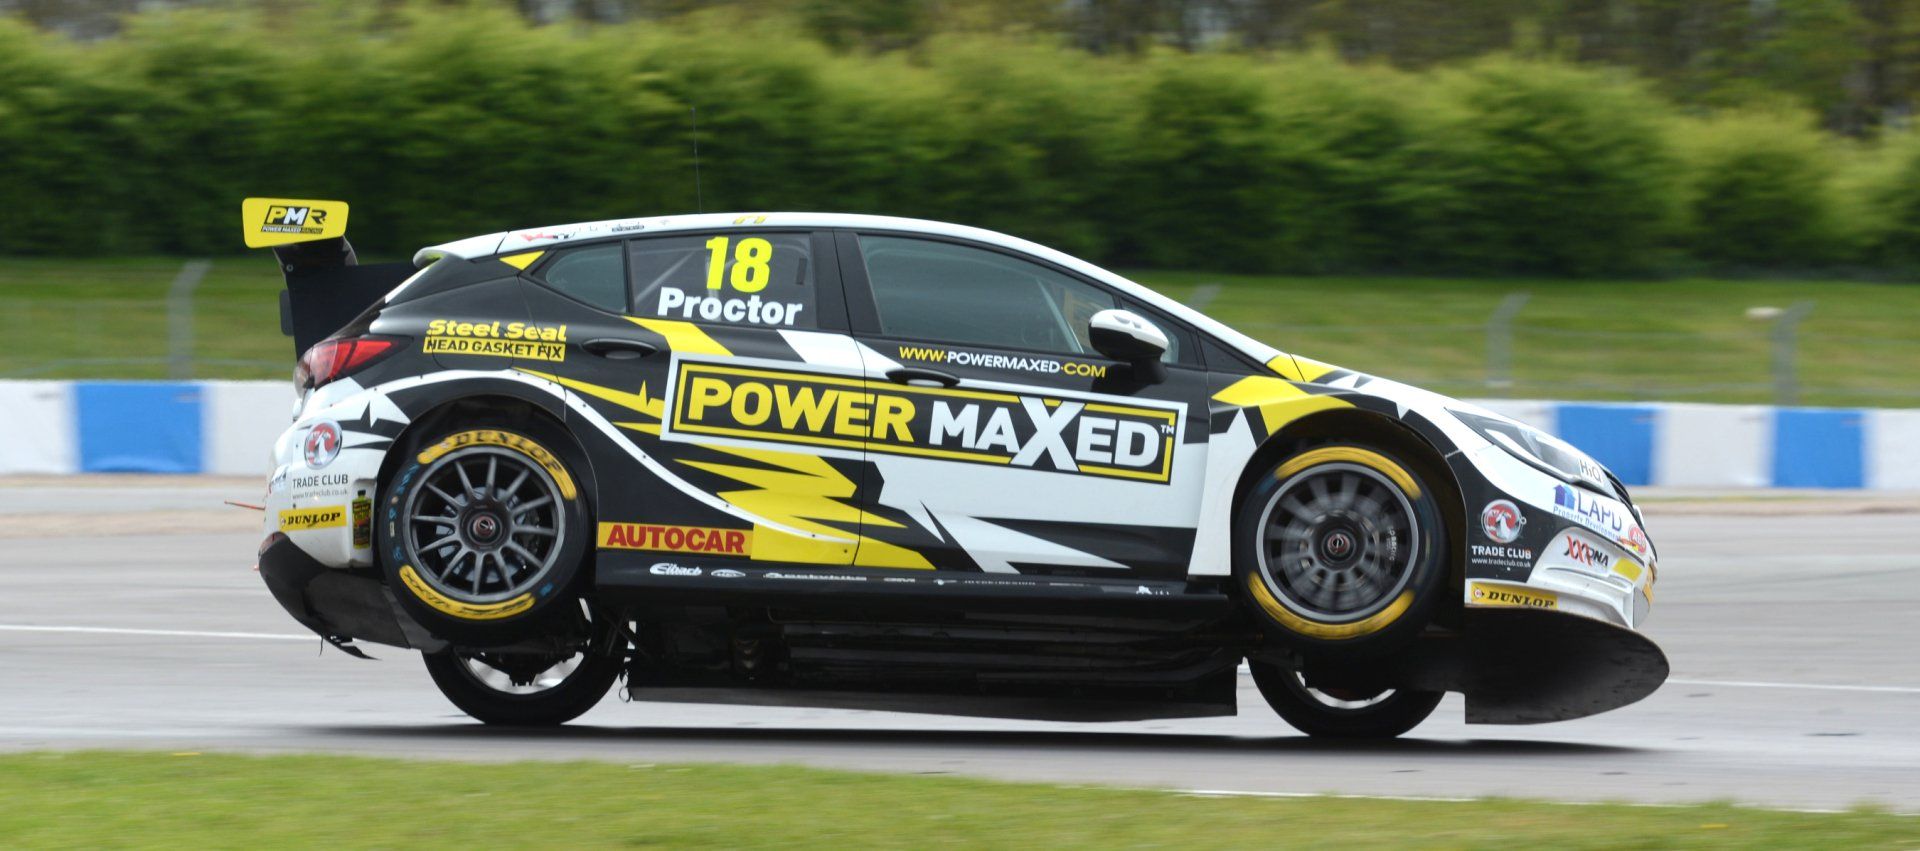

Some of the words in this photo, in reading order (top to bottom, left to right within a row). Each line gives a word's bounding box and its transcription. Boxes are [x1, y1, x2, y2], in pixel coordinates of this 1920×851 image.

[705, 236, 772, 293] 18
[657, 286, 803, 326] Proctor
[426, 319, 500, 338] Steel
[504, 322, 567, 342] Seal
[426, 339, 468, 351] HEAD
[472, 341, 533, 356] GASKET
[537, 344, 562, 359] FIX
[687, 376, 916, 442] POWER
[928, 396, 1161, 472] MAXED
[292, 475, 319, 489] TRADE
[321, 474, 349, 486] CLUB
[287, 511, 341, 527] DUNLOP
[606, 525, 745, 553] AUTOCAR
[1471, 545, 1504, 557] TRADE
[1507, 548, 1532, 560] CLUB
[649, 562, 702, 576] Eibach
[1471, 557, 1531, 568] www.tradeclub.co.uk
[1488, 590, 1555, 608] DUNLOP
